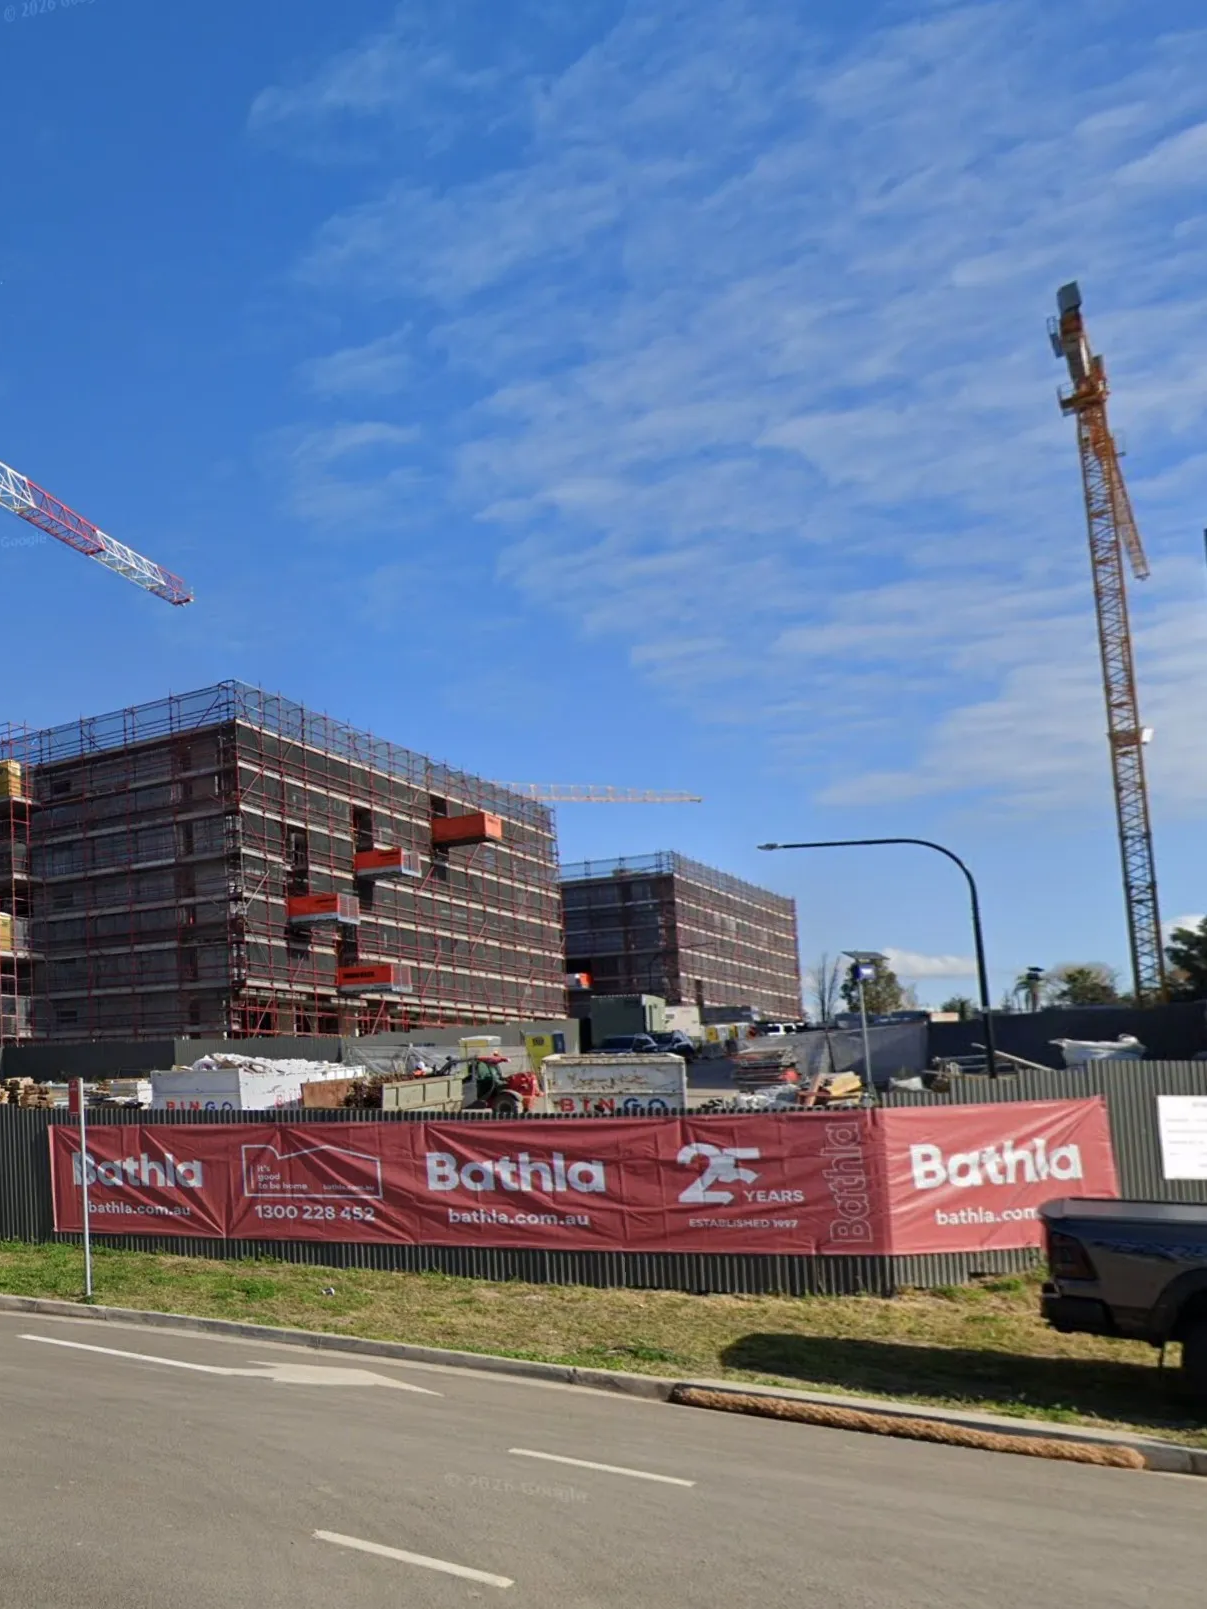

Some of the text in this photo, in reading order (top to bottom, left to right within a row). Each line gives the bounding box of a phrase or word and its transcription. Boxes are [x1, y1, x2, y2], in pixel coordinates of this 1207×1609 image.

[72, 1152, 203, 1188] Bathla
[426, 1151, 606, 1192] Bathla
[909, 1138, 1083, 1190] Bathla
[257, 1172, 281, 1183] good
[258, 1181, 308, 1190] to be home
[821, 1122, 873, 1243] Bathla
[744, 1190, 806, 1203] YEARS
[88, 1201, 191, 1216] bathla.com.au
[254, 1205, 376, 1221] 1300 228 452
[448, 1208, 591, 1226] bathla.com.au
[935, 1206, 1040, 1226] bathla.com
[688, 1218, 770, 1229] ESTABLISHED
